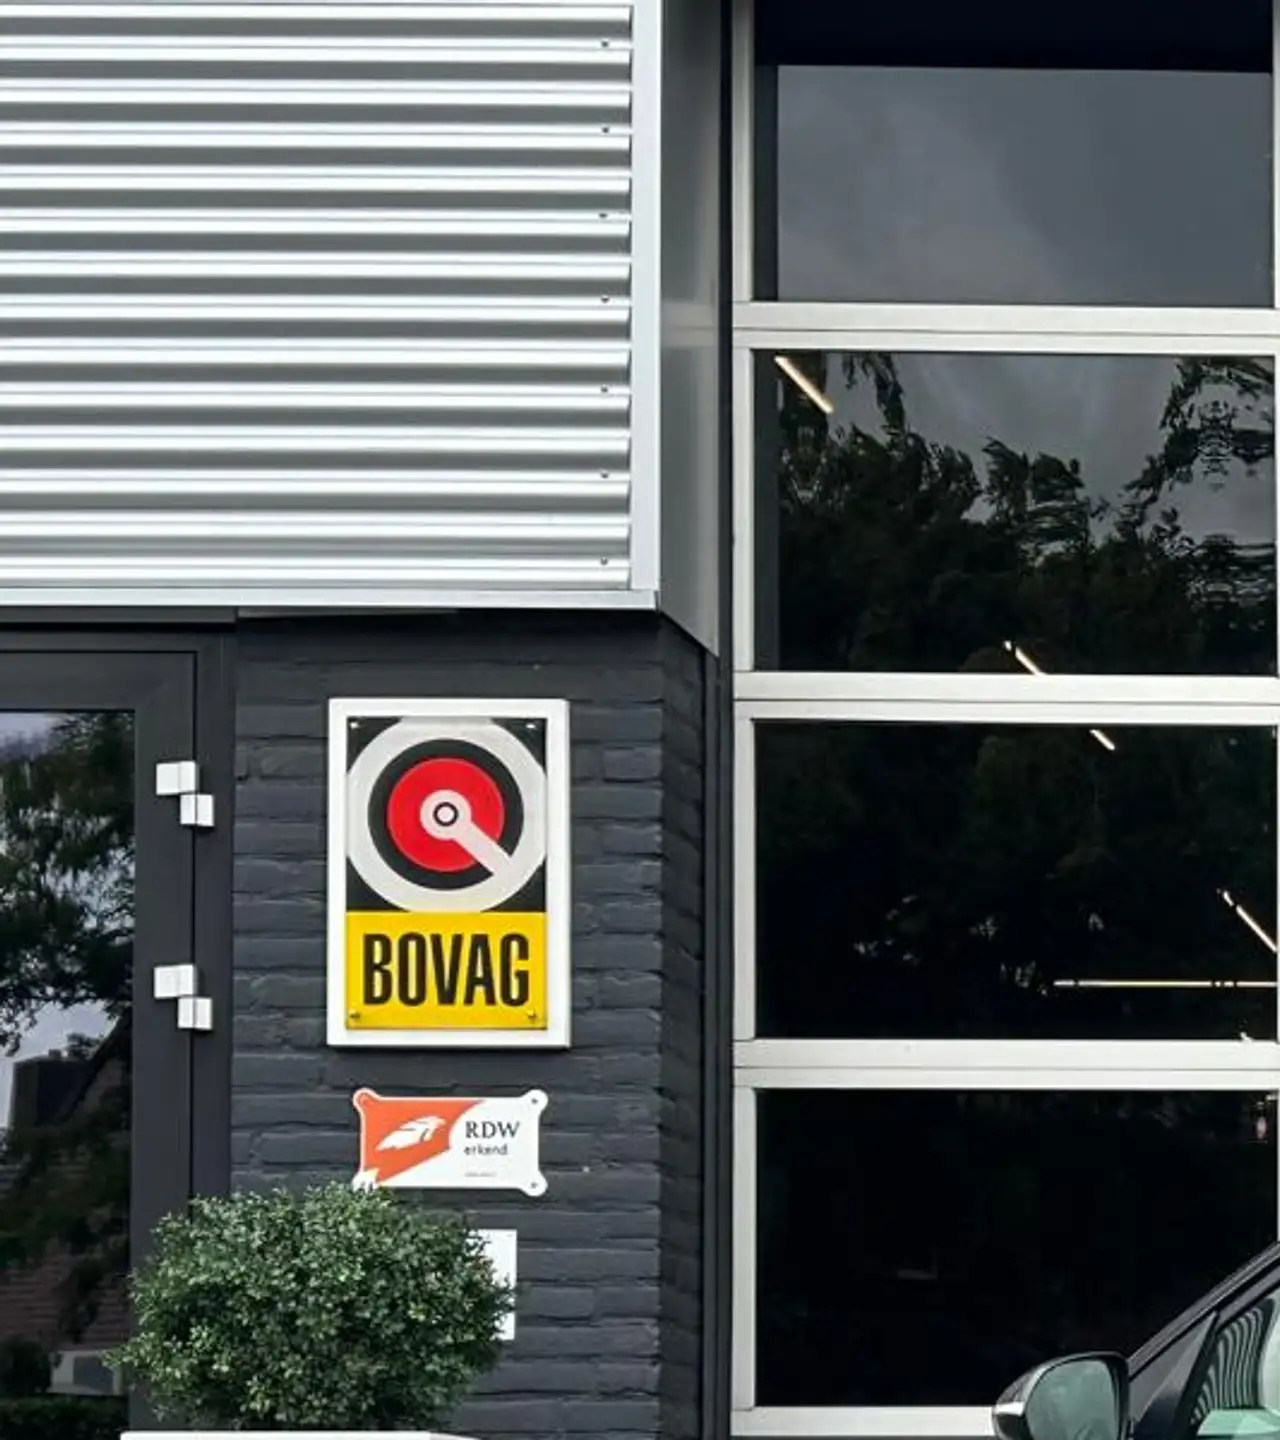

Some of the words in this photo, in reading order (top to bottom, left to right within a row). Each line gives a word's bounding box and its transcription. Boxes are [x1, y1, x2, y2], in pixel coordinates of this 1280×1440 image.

[363, 932, 529, 1007] BOVAG
[465, 1120, 520, 1139] RDW
[464, 1143, 508, 1156] erkend
